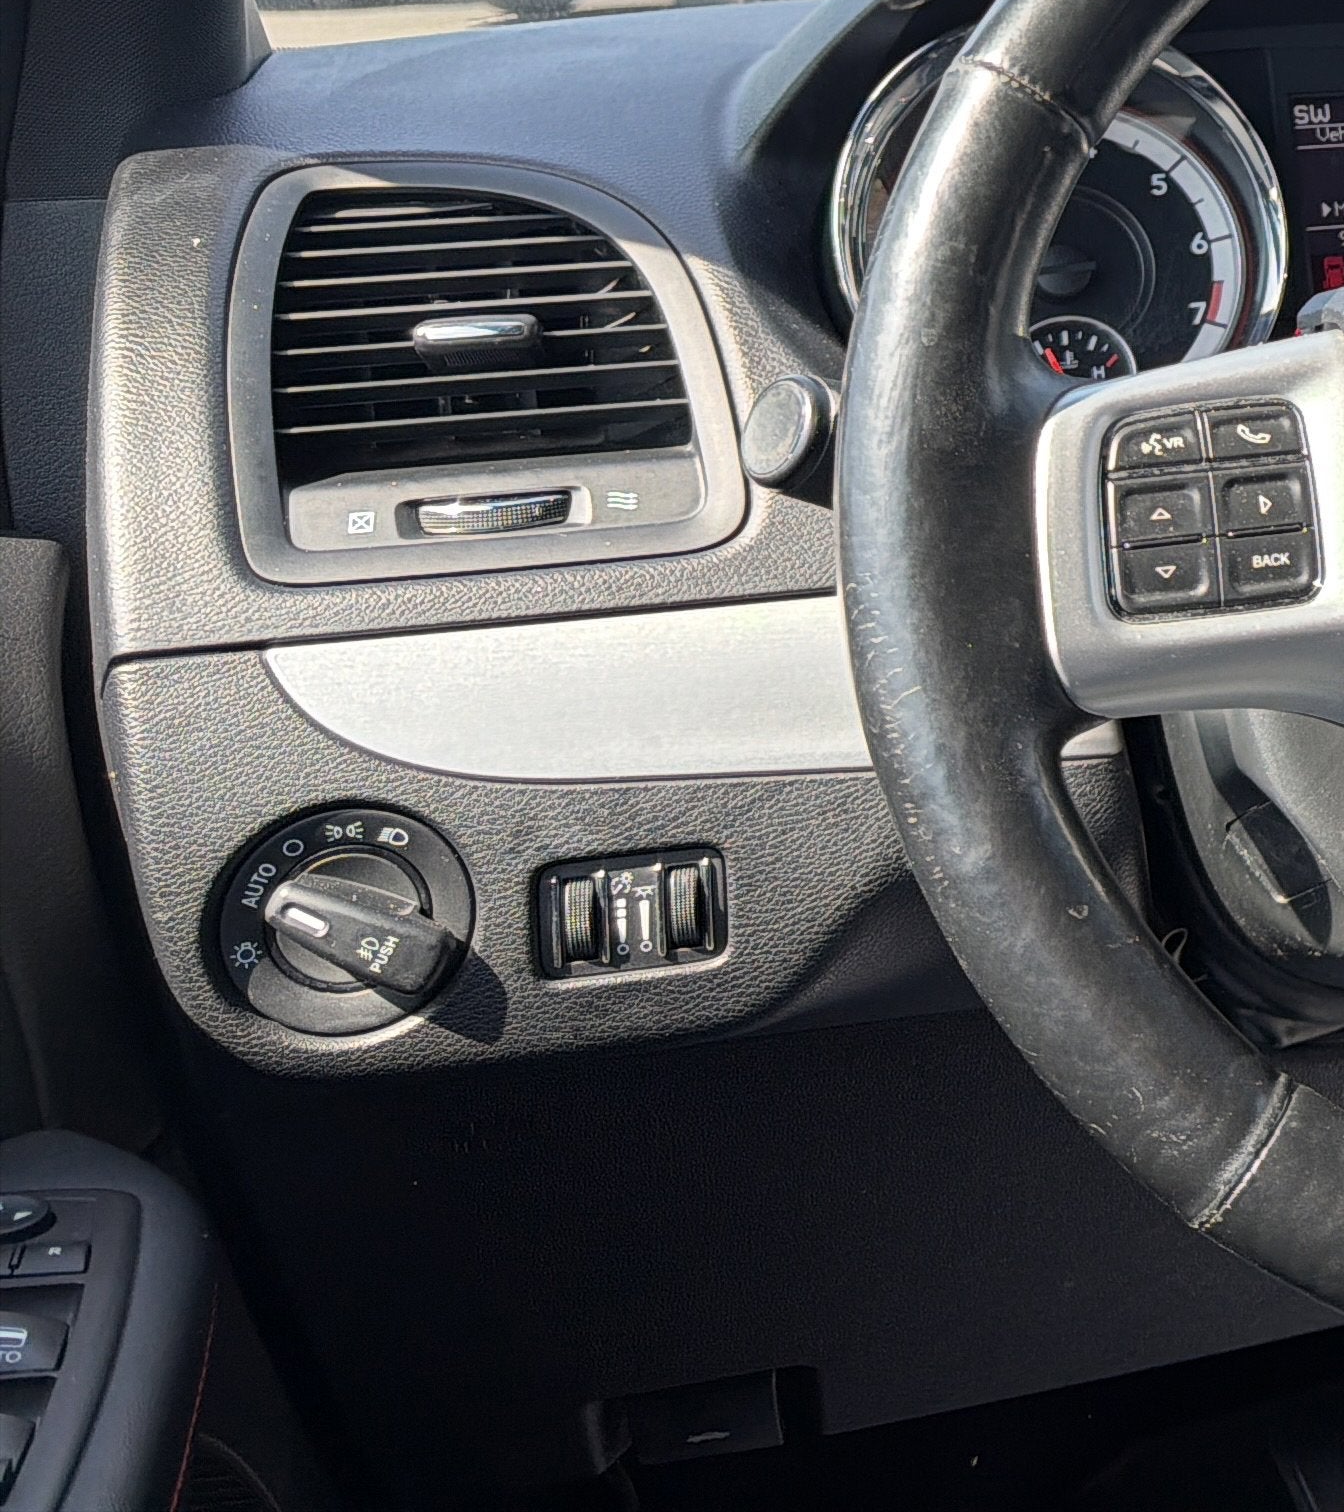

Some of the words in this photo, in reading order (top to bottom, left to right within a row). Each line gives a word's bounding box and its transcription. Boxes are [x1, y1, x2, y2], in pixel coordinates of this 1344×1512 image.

[1293, 103, 1331, 125] SW
[1150, 173, 1168, 196] 5
[1189, 231, 1209, 255] 6
[1187, 301, 1207, 326] 7
[1091, 365, 1106, 380] H
[1164, 436, 1185, 450] VR
[1252, 552, 1290, 569] BACK
[241, 863, 277, 909] AUTO
[370, 934, 399, 974] PUSH
